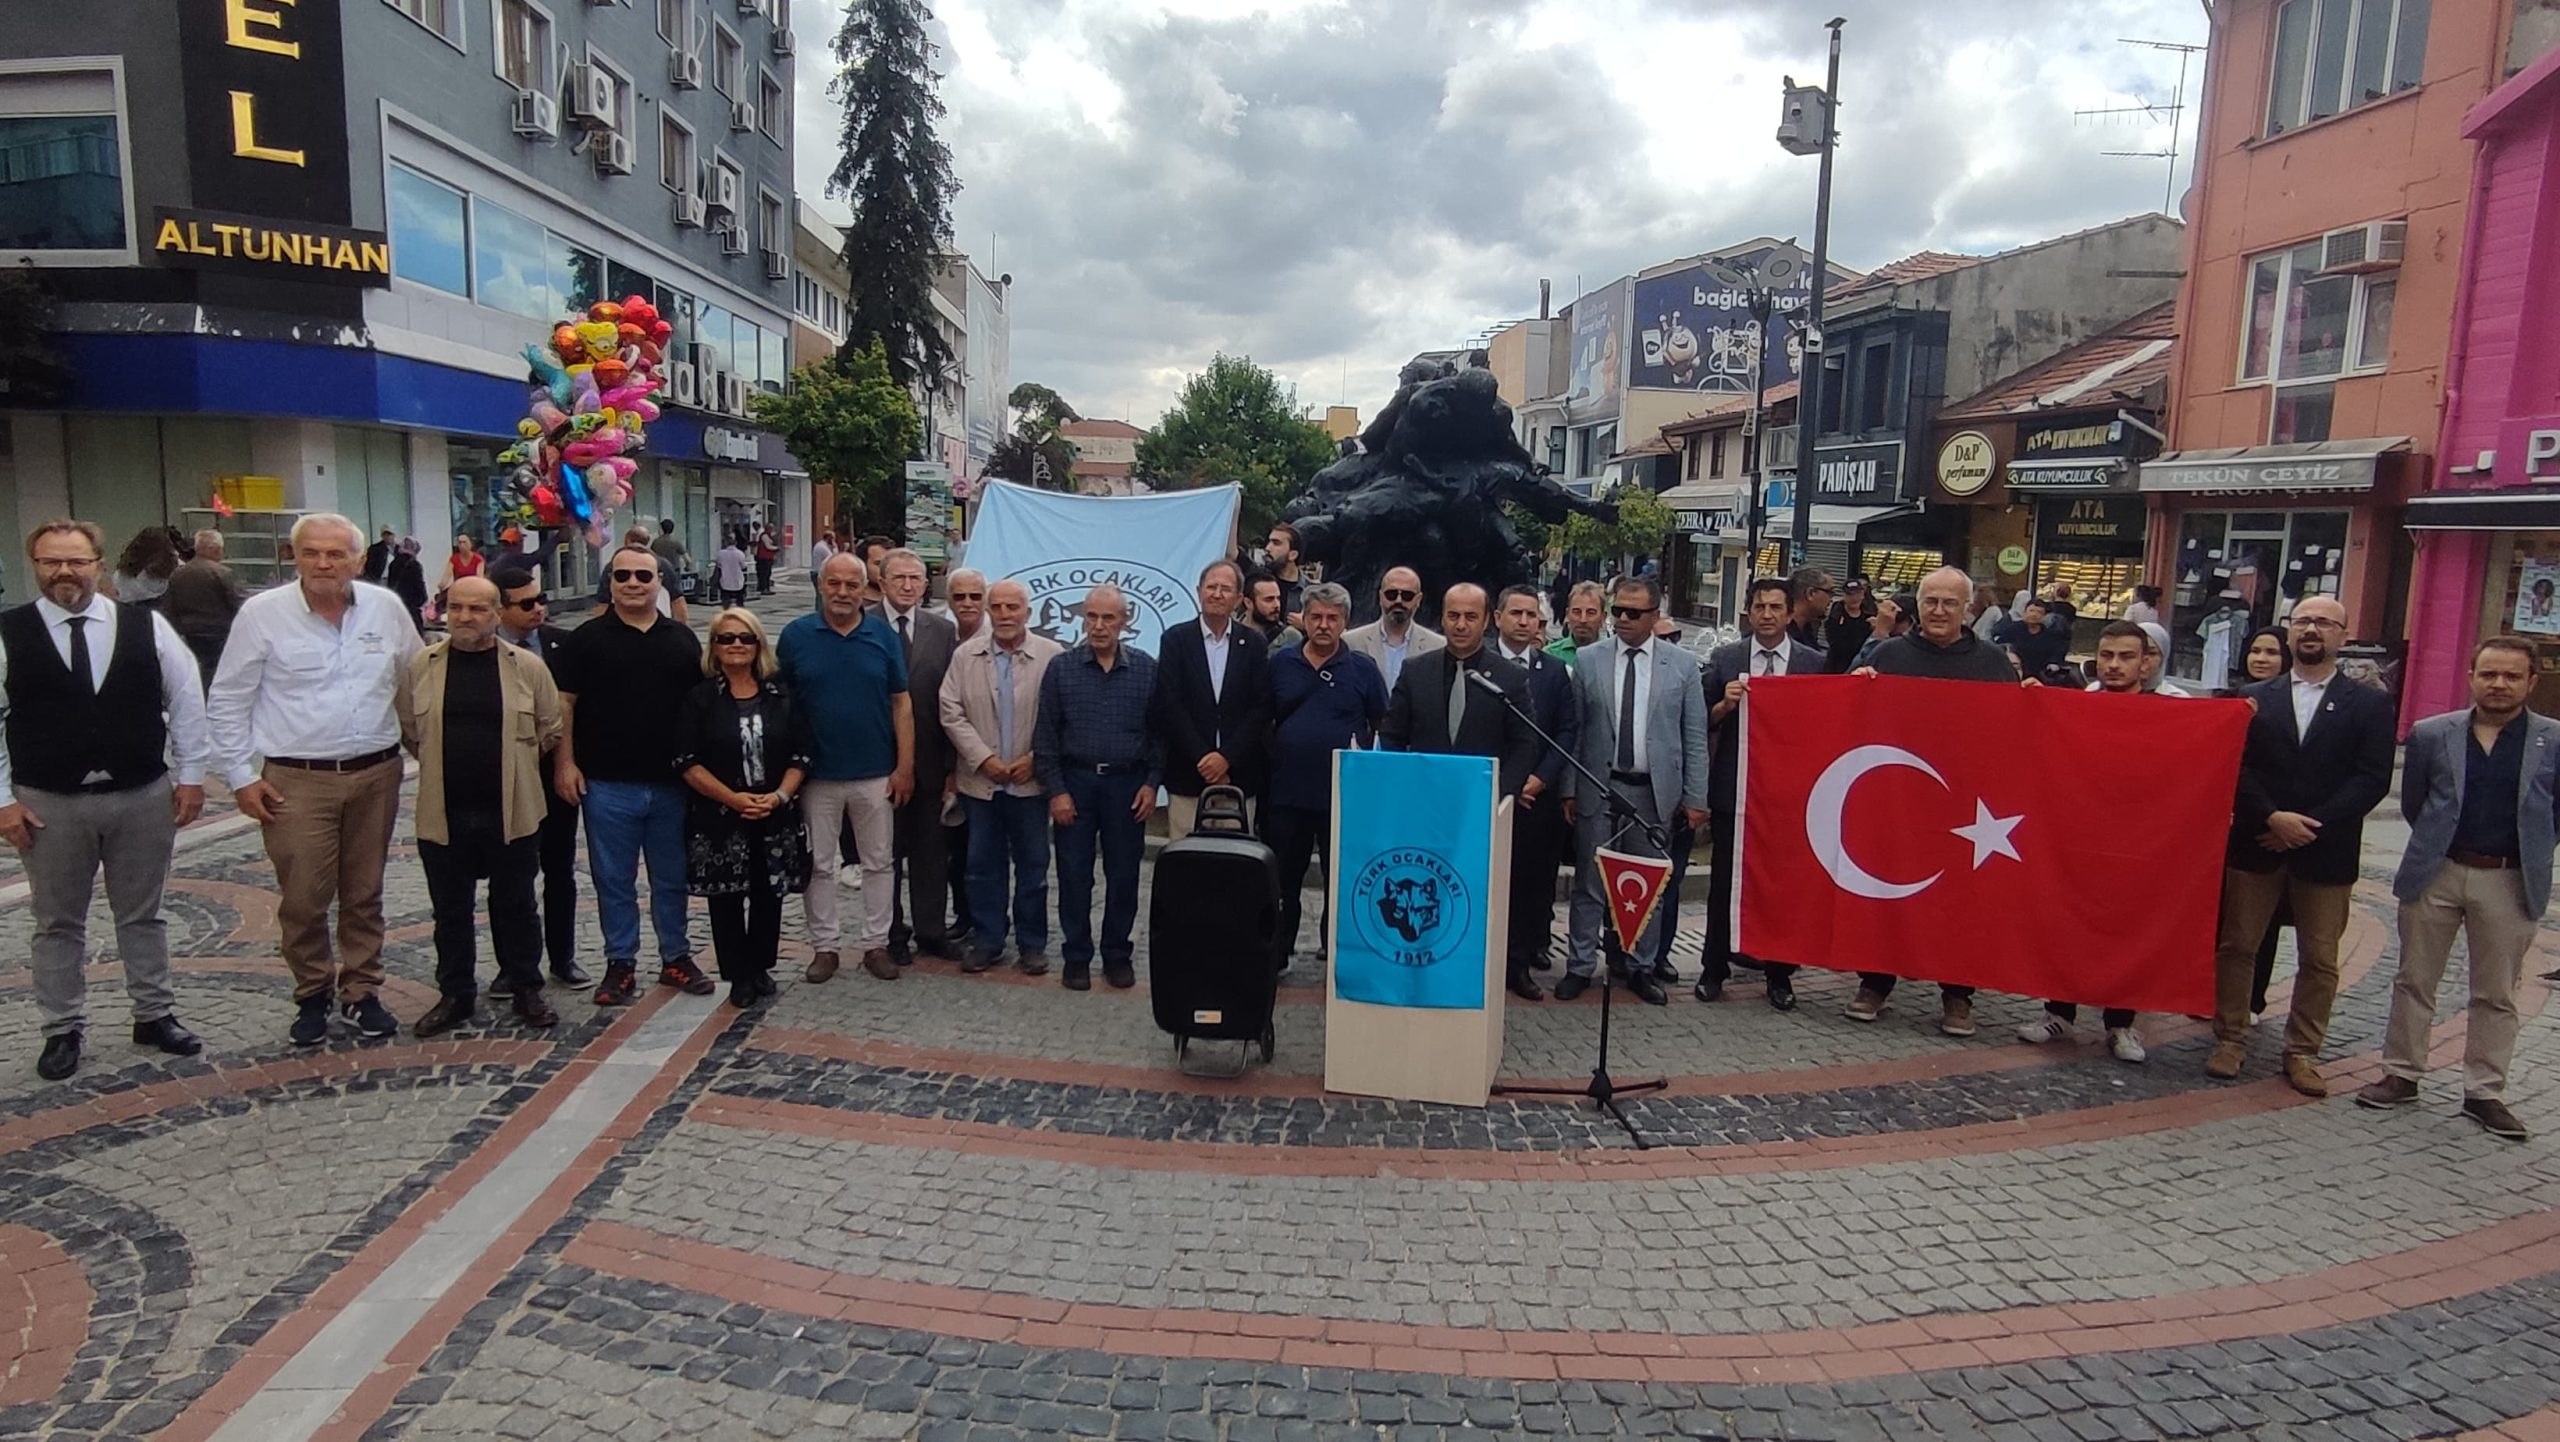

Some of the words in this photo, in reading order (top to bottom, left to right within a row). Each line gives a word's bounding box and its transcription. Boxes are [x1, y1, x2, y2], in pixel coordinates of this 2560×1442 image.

[155, 218, 390, 275] ALTUNHAN
[2026, 428, 2052, 452] ATA
[1954, 443, 1980, 462] D&P
[1818, 455, 1877, 498] PADİŞAH
[2020, 471, 2036, 483] ATA
[2036, 469, 2094, 484] KUYUMCULUK
[2168, 466, 2251, 485] TEKÜN
[2260, 463, 2341, 483] ÇEYİZ
[2070, 499, 2105, 519] ATA
[2057, 523, 2118, 536] KUYUMCULUK
[1029, 572, 1063, 594] RK
[1069, 569, 1179, 612] OCAKLARI
[1358, 861, 1389, 897] TÜRK
[1392, 852, 1463, 898] OCAKLARI
[1394, 949, 1436, 966] 1912
